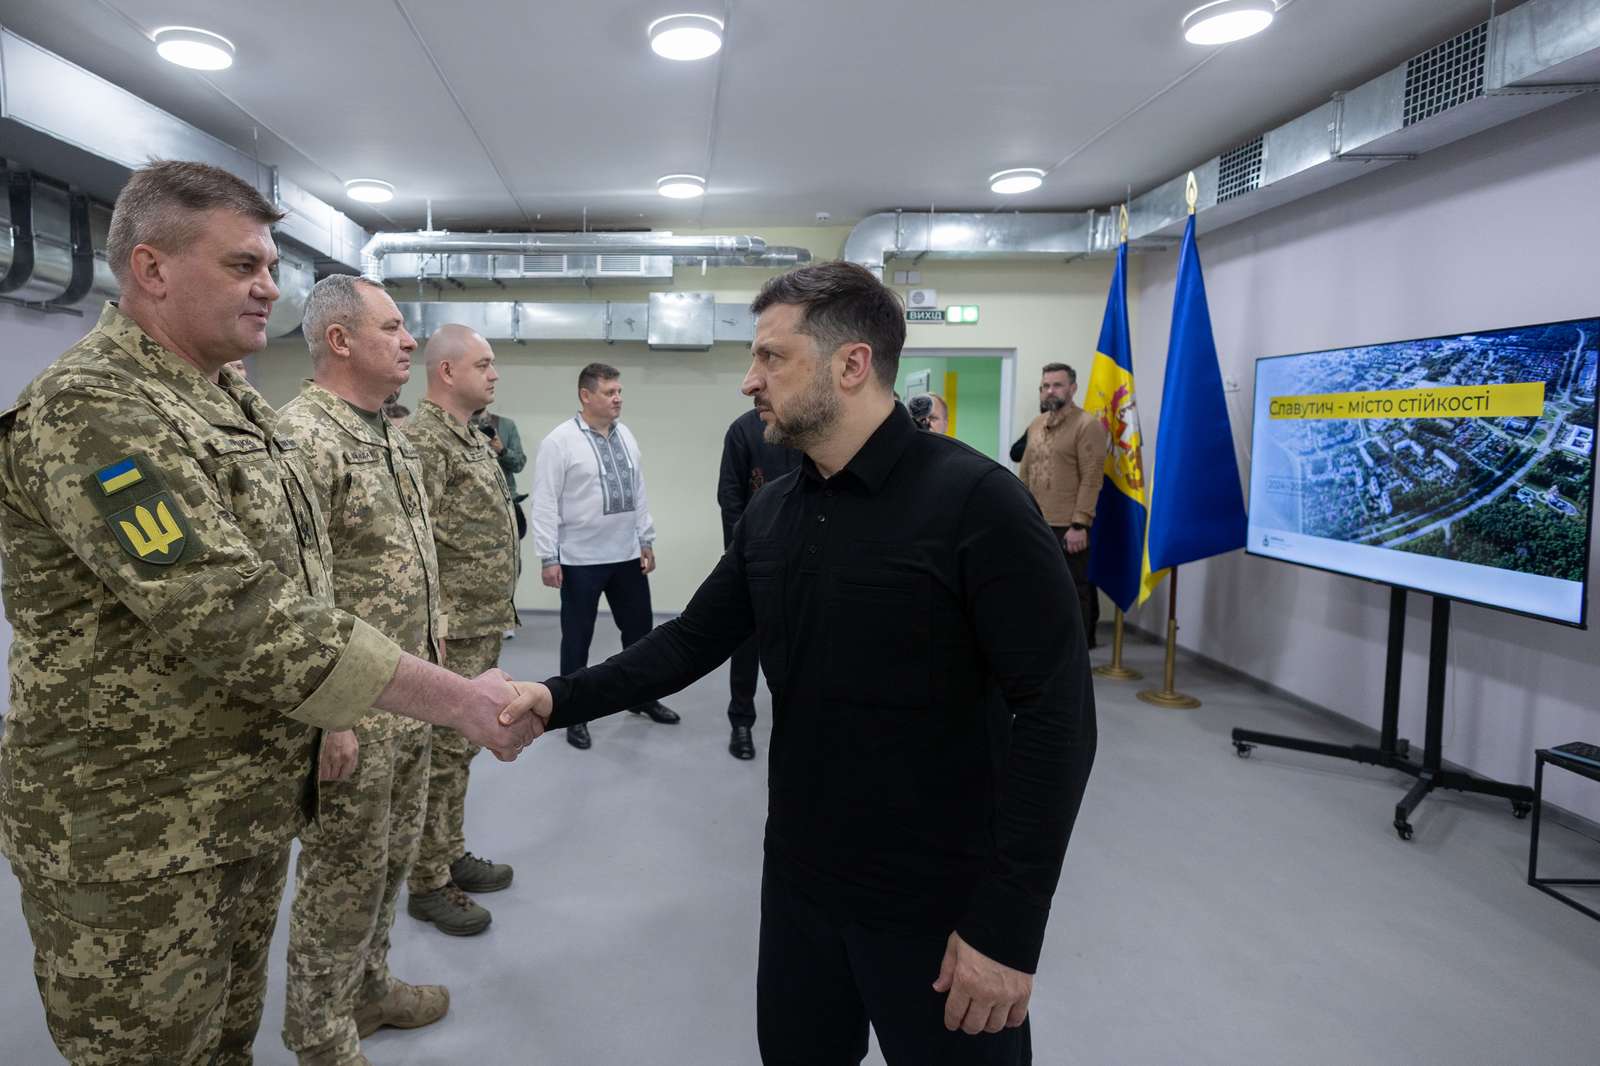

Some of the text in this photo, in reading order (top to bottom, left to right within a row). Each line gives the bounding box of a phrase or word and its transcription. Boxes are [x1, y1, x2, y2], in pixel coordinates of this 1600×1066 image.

[910, 311, 942, 320] ВИХІД
[1269, 400, 1333, 418] Славутич
[1348, 396, 1393, 414] місто
[1398, 390, 1490, 413] стійкості
